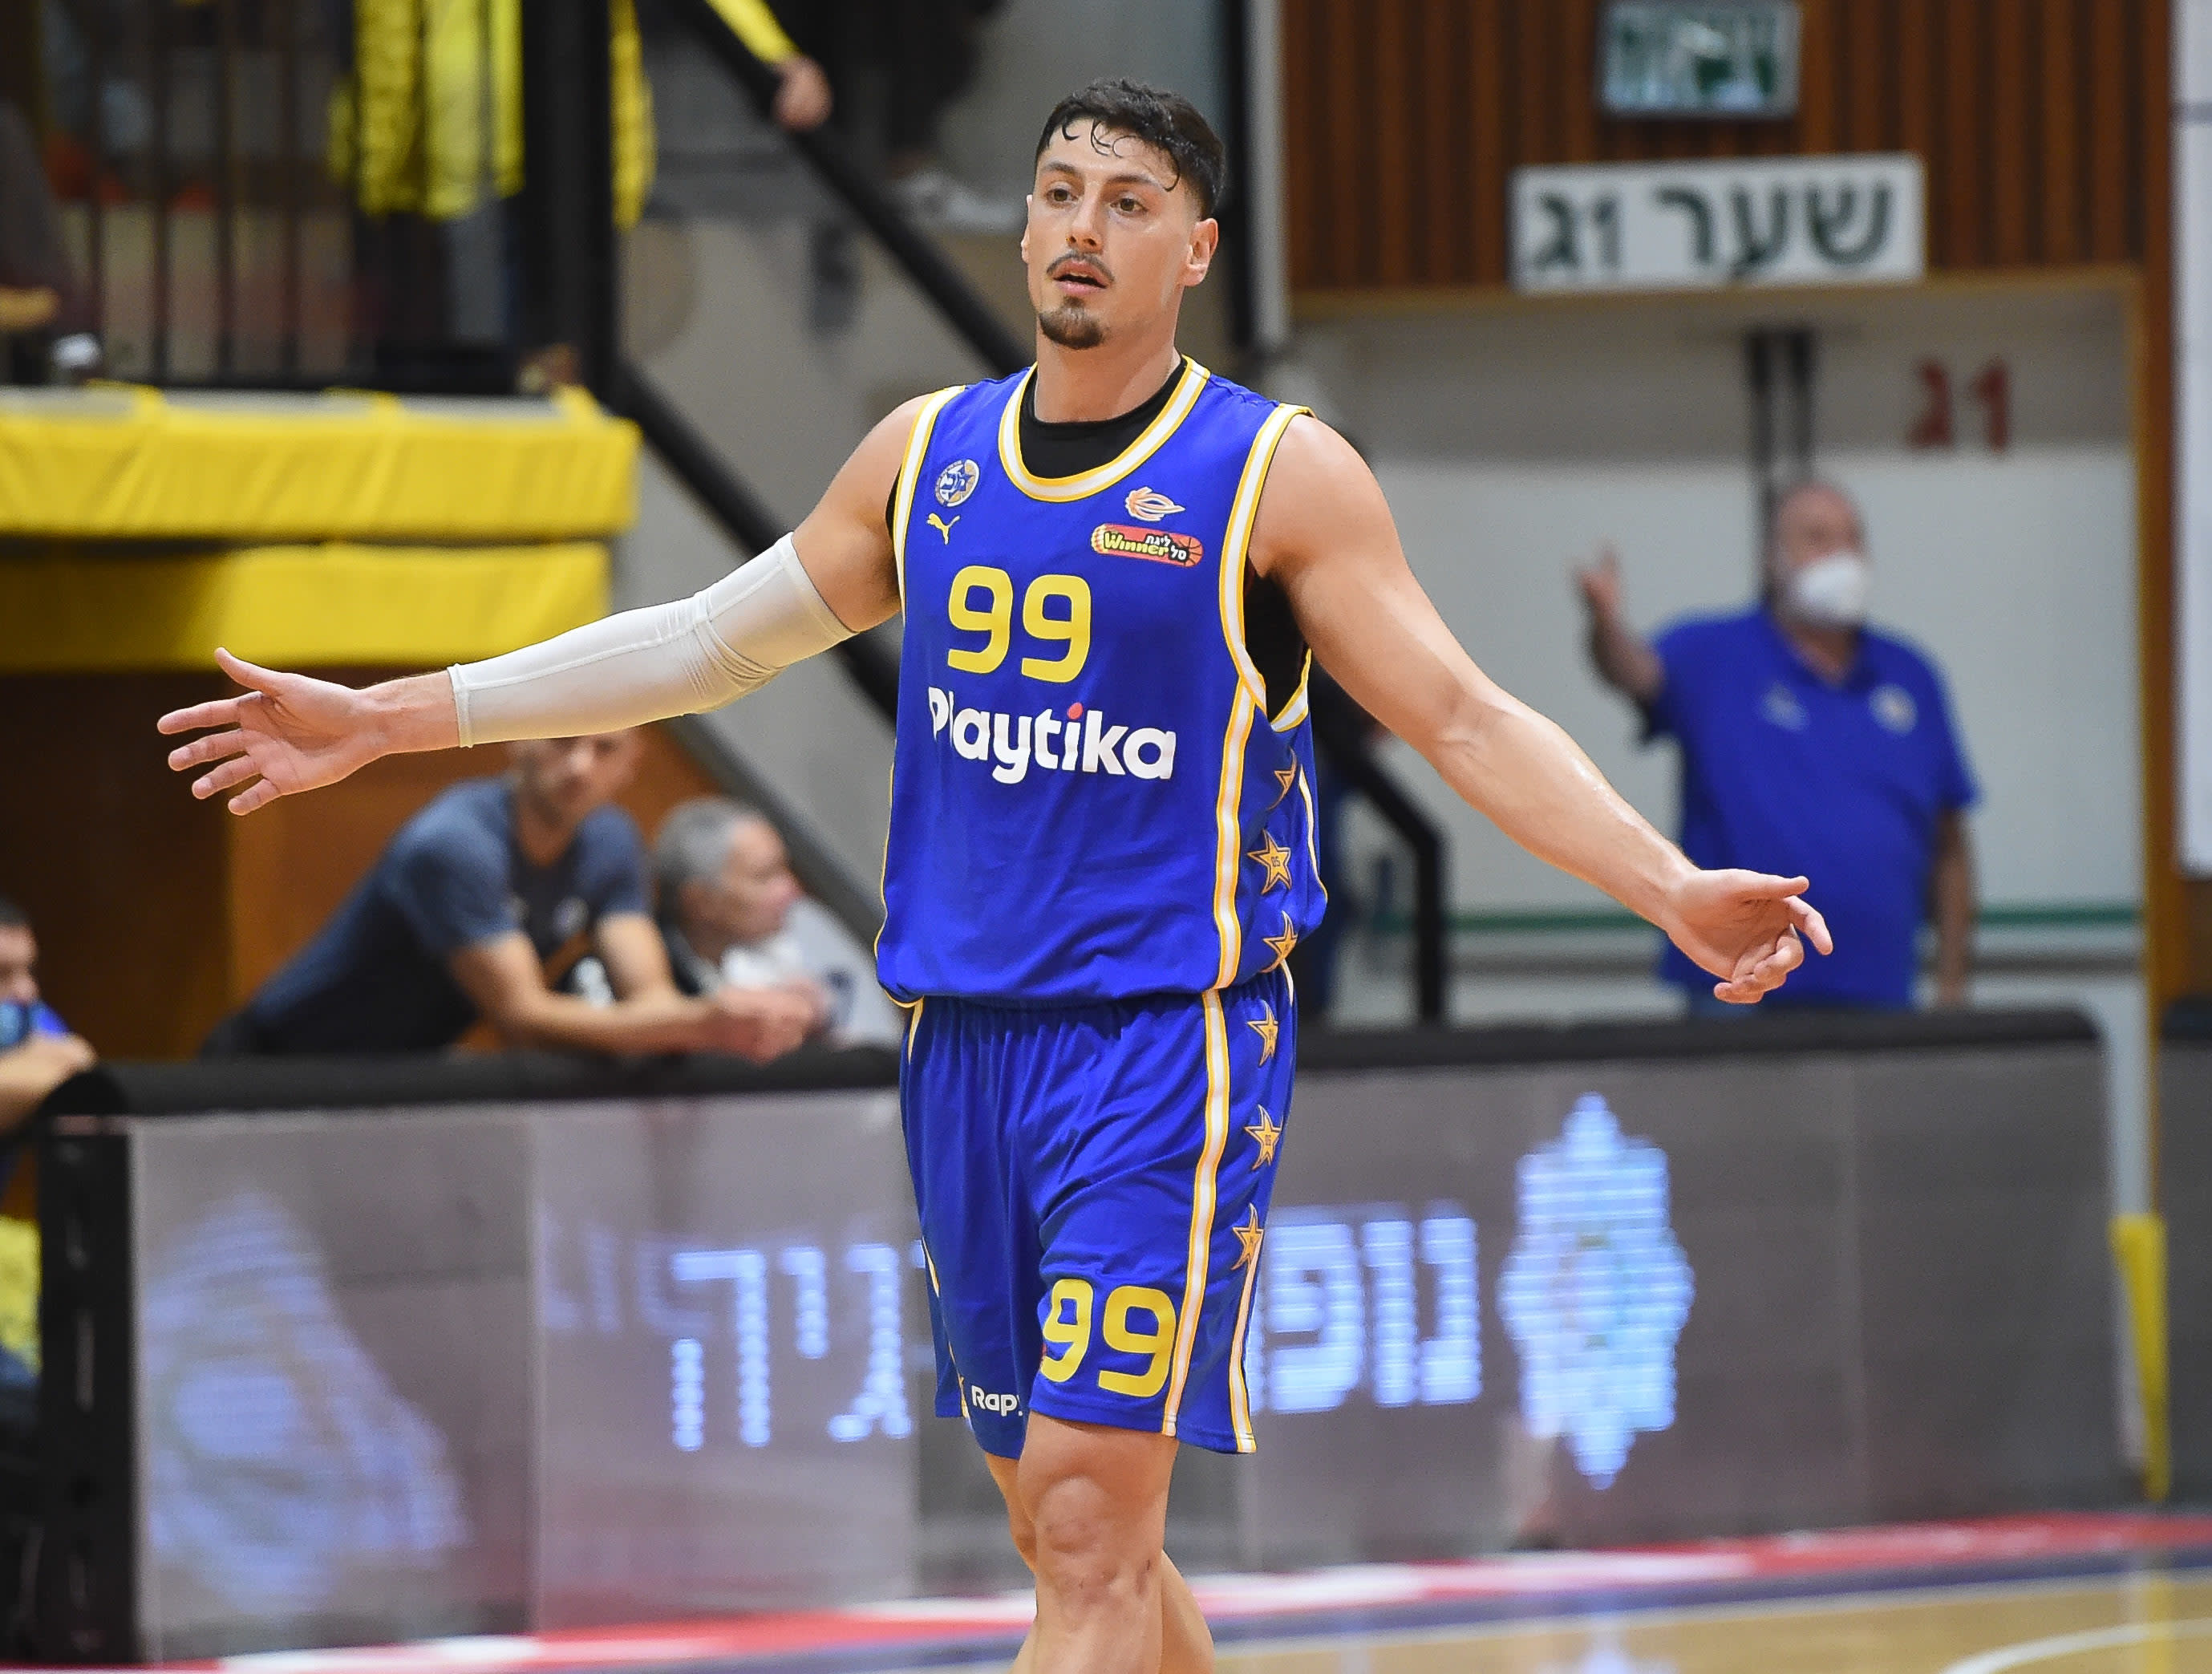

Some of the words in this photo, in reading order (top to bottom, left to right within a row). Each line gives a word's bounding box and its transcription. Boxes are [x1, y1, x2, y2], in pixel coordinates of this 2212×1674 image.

[1652, 177, 1894, 278] שער
[1104, 530, 1169, 556] Winner
[1170, 545, 1187, 561] סל
[947, 565, 1092, 683] 99
[927, 686, 1177, 784] Playtika
[1039, 1278, 1177, 1398] 99
[970, 1384, 1023, 1417] Rap
